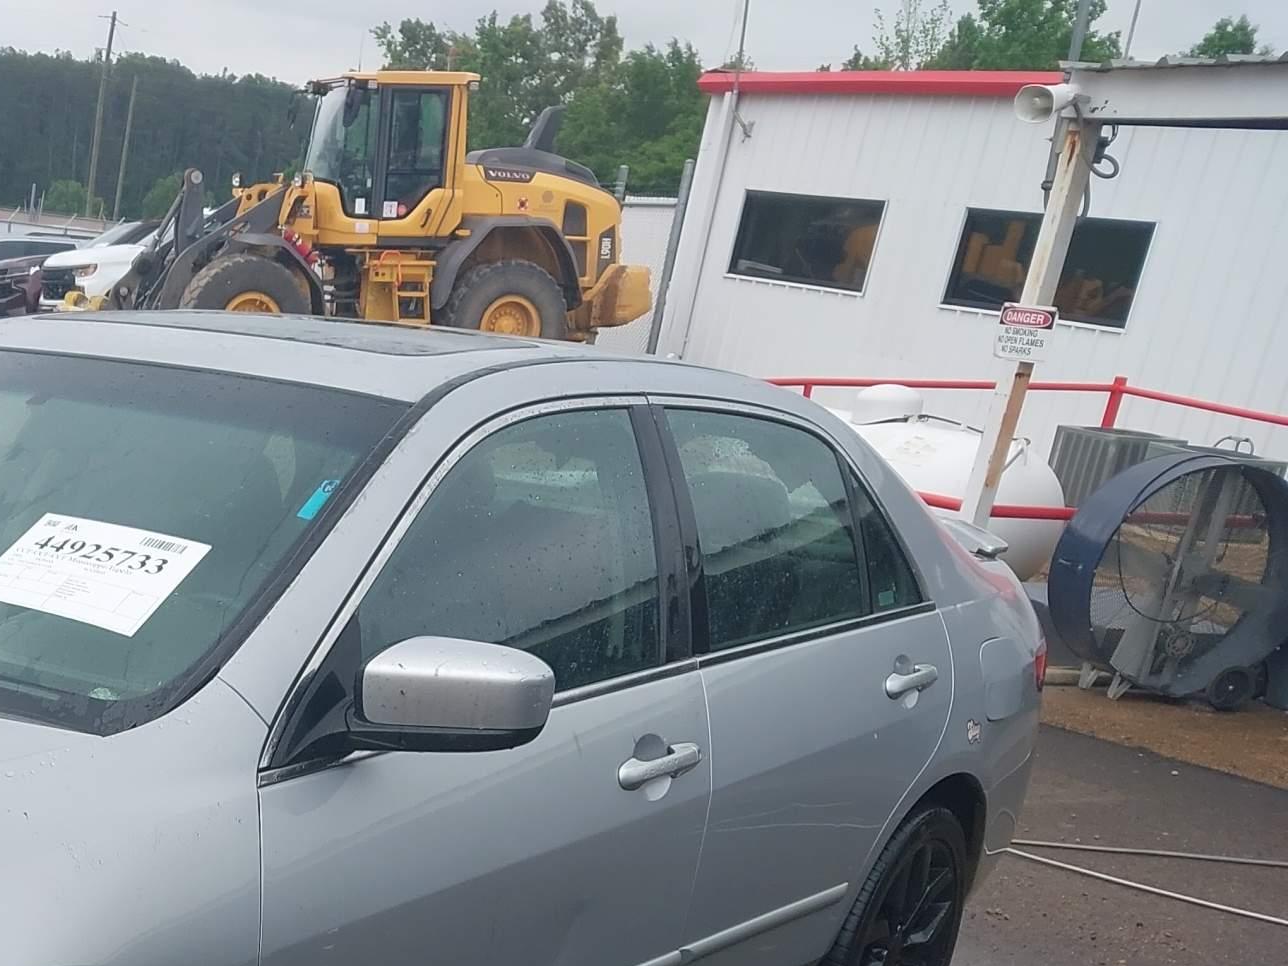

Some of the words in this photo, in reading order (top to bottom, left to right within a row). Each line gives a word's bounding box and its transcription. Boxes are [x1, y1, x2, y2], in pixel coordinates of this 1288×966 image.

[487, 169, 531, 180] VOLVO
[601, 237, 612, 260] L90H
[1006, 311, 1045, 325] DANGER
[1012, 328, 1038, 337] SMOKING
[1019, 338, 1044, 348] FLAMES
[1009, 345, 1032, 356] SPARKS
[34, 535, 169, 575] 44925733
